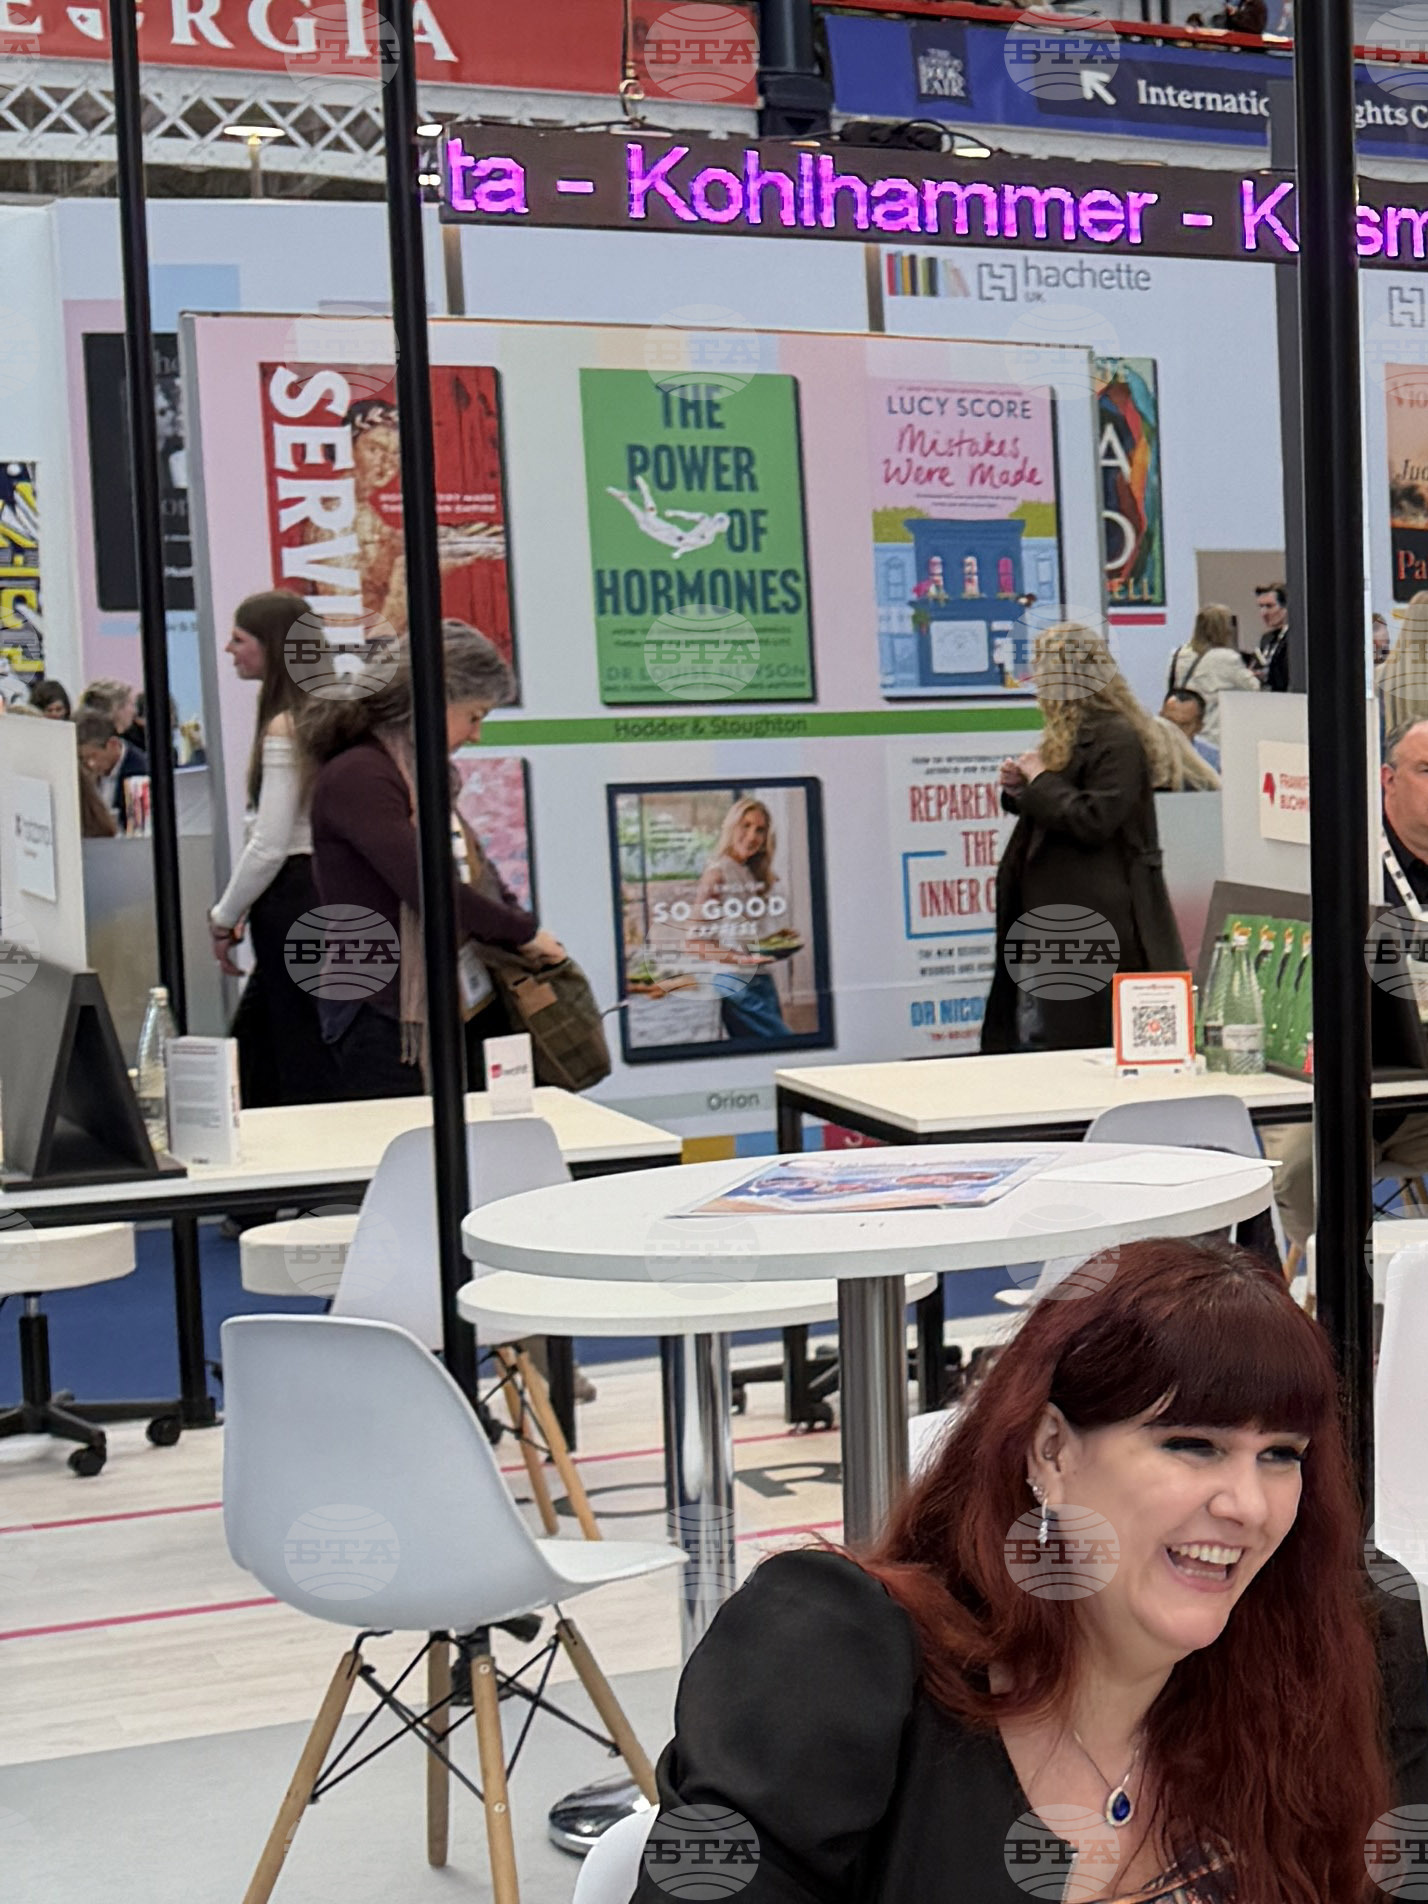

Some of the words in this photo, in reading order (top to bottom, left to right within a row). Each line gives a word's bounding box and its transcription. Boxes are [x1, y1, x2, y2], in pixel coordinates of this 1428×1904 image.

[1354, 100, 1408, 128] ghts
[626, 142, 1159, 245] Kohlhammer
[1023, 255, 1152, 292] hachette
[655, 382, 726, 430] THE
[886, 395, 949, 417] LUCY
[956, 397, 1033, 420] SCORE
[896, 422, 1021, 459] Mistakes
[626, 443, 760, 494] POWER
[882, 457, 955, 487] Were
[968, 456, 1045, 490] Made
[725, 507, 769, 554] OF
[594, 567, 803, 616] HORMONES
[613, 718, 687, 738] Hodder
[709, 715, 808, 737] Stoughton
[961, 829, 1000, 868] THE
[652, 900, 691, 924] SO
[701, 895, 788, 920] GOOD
[918, 877, 981, 918] INNER
[706, 1092, 761, 1112] Orion
